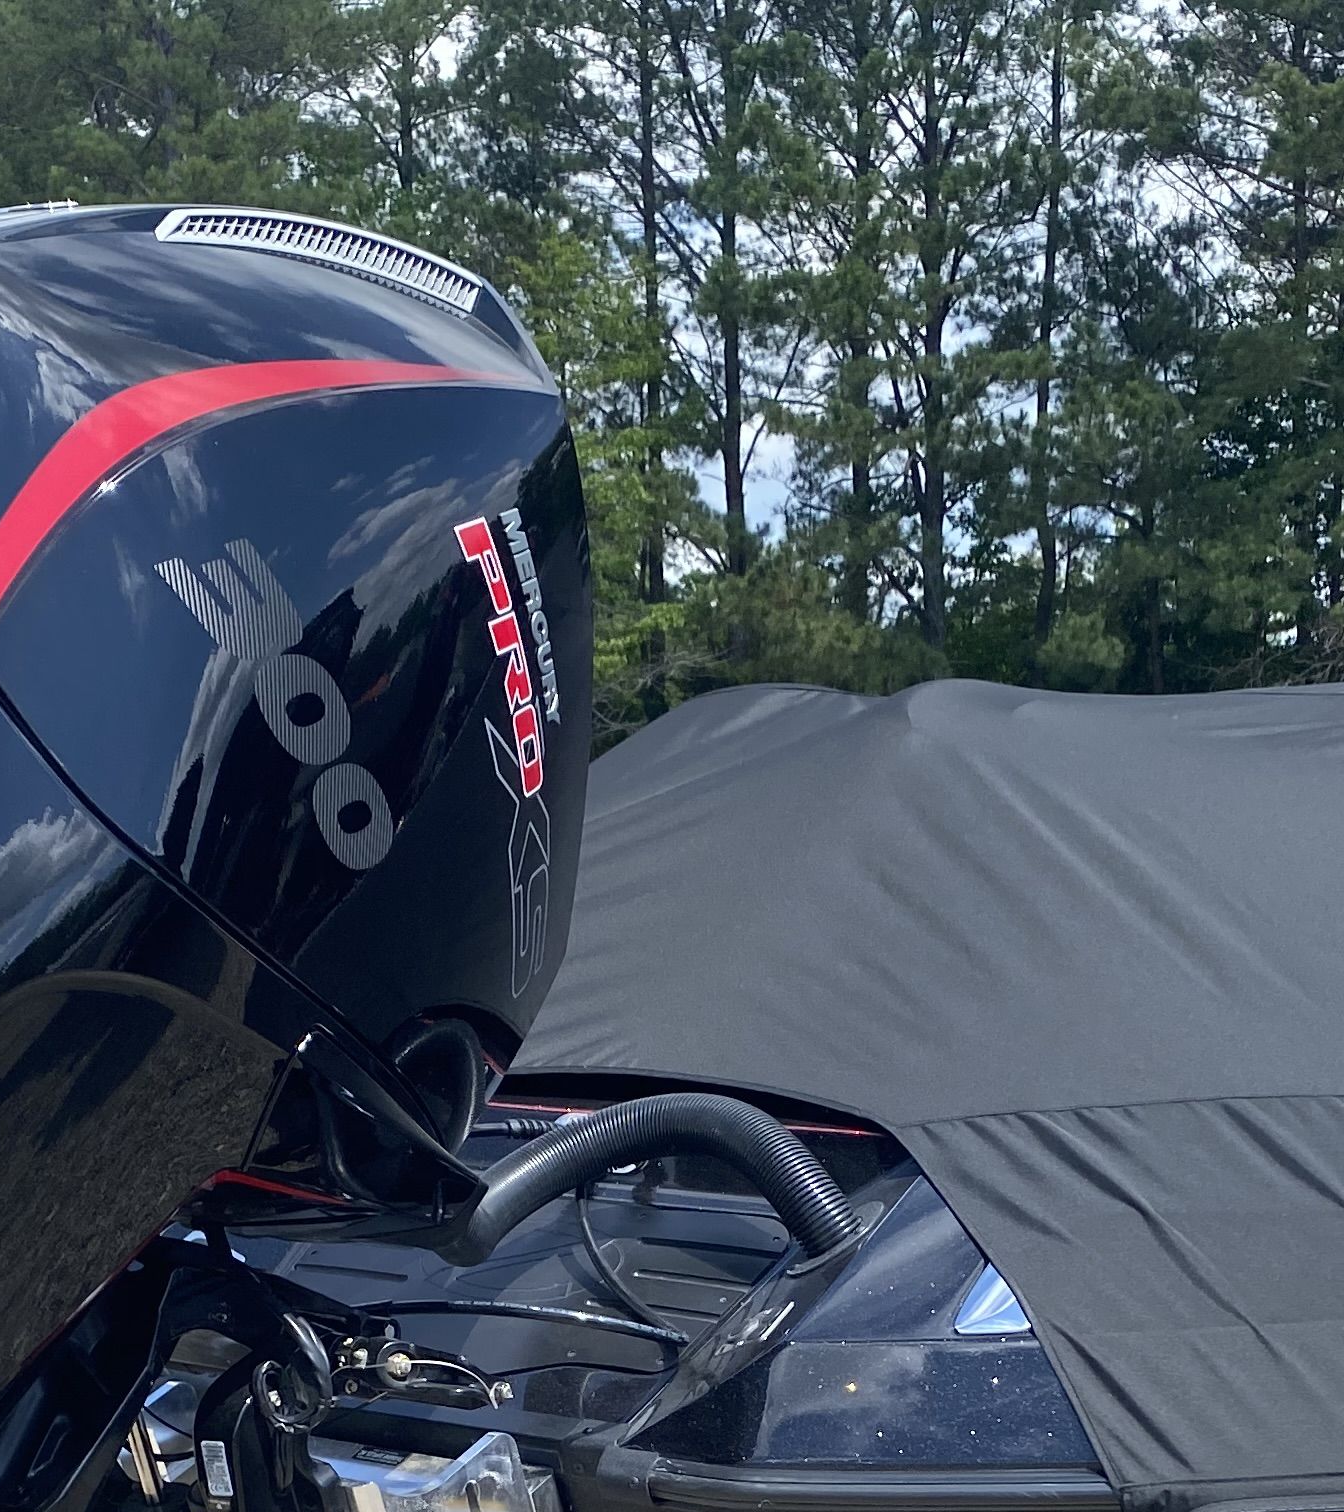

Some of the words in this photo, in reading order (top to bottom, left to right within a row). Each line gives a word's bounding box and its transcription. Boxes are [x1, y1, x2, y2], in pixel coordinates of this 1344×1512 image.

[154, 537, 394, 870] 300
[454, 515, 544, 798] PRO
[499, 507, 561, 725] MERCURY
[483, 696, 549, 998] XS
